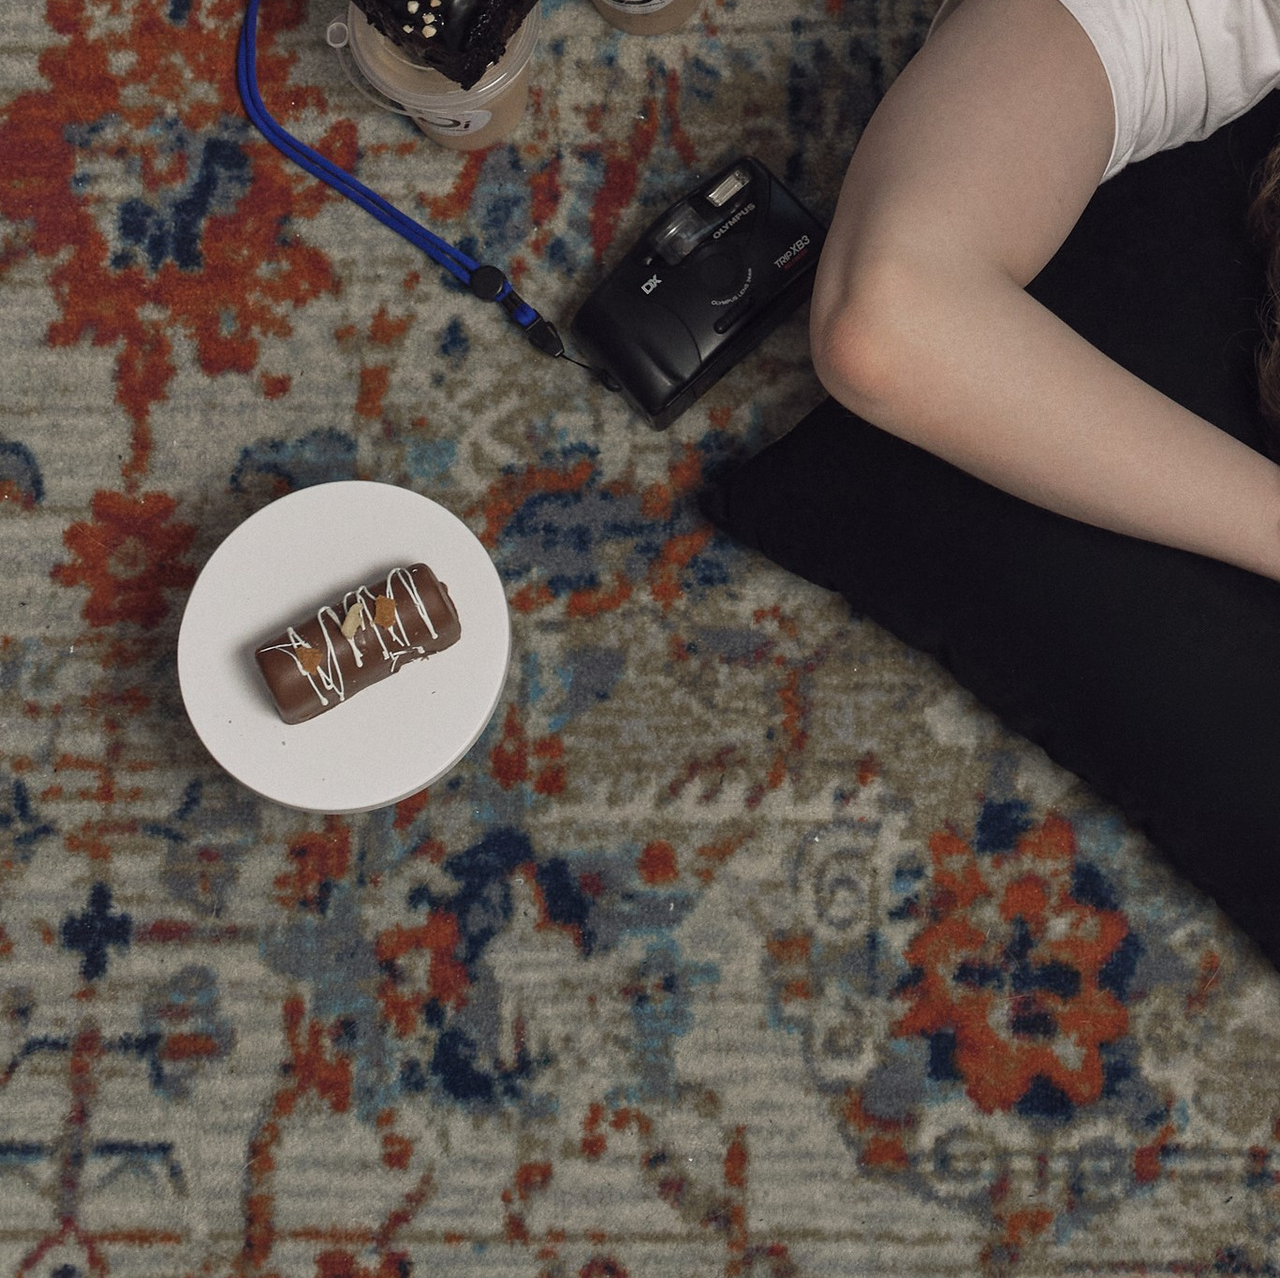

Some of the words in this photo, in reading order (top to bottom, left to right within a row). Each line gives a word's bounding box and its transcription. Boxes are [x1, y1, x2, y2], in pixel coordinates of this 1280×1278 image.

[712, 202, 756, 240] OLYMPUS
[640, 274, 662, 295] DX
[711, 295, 739, 306] OLYMPUS
